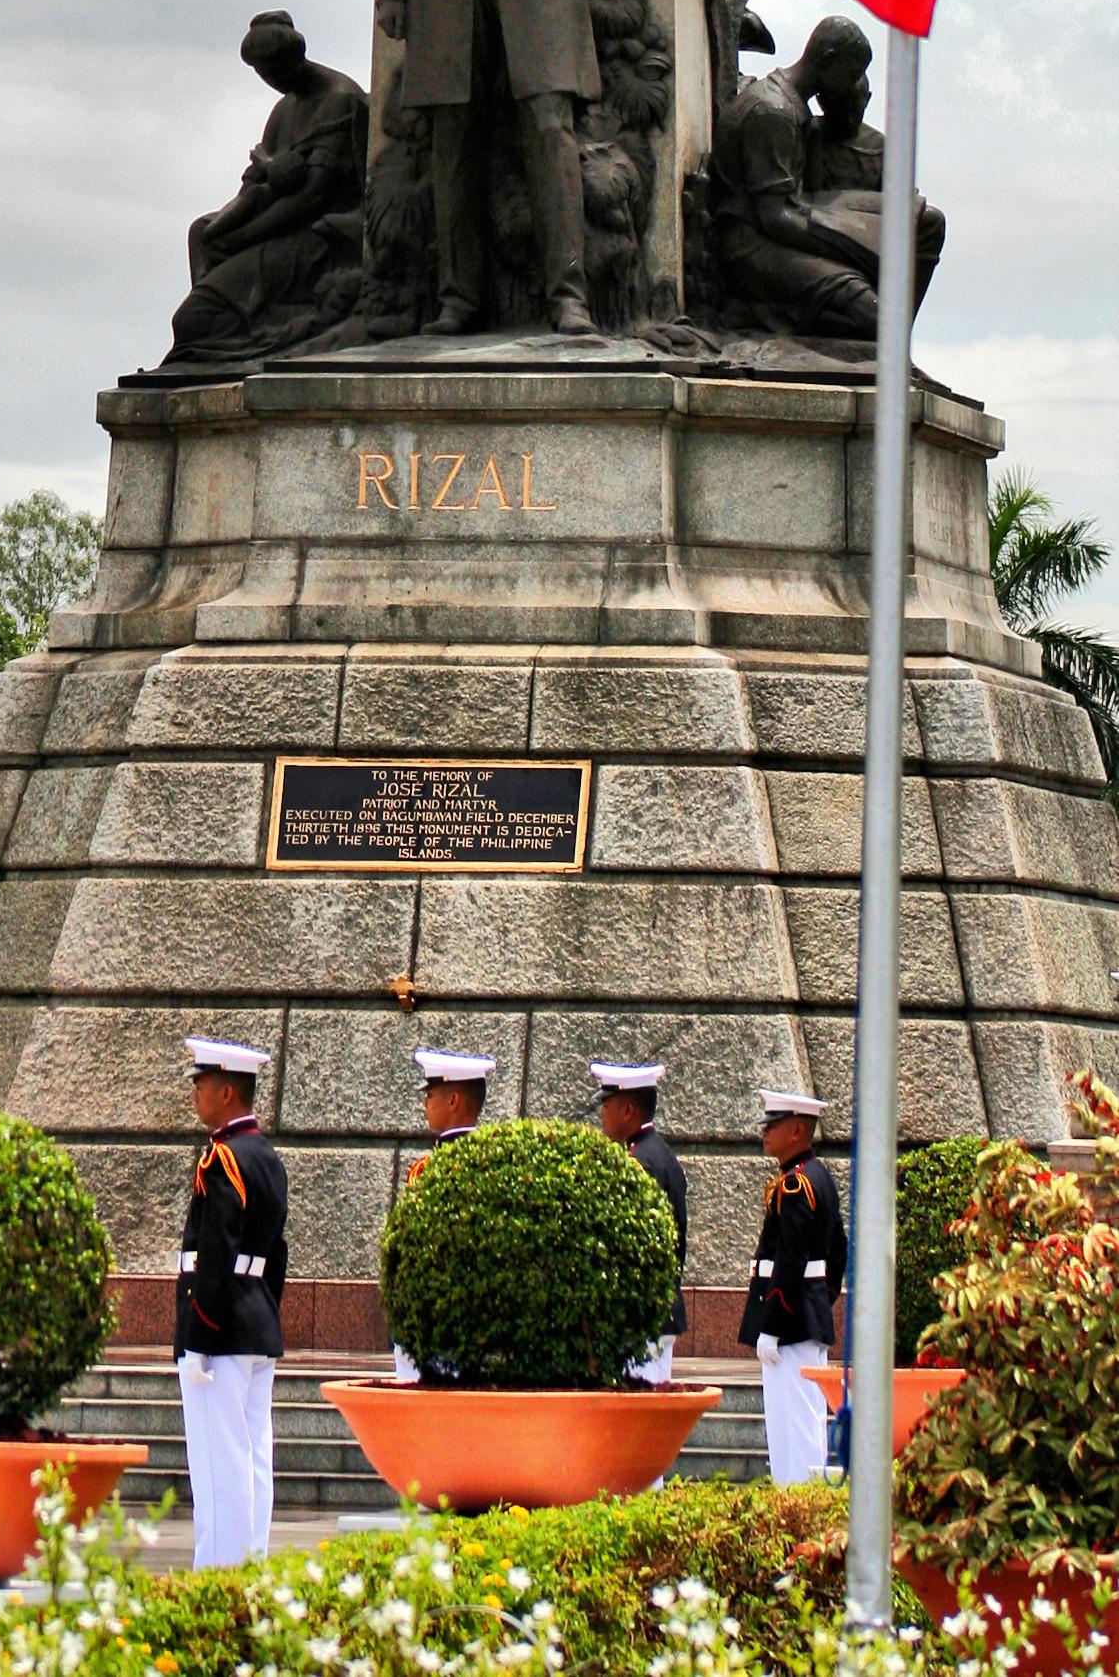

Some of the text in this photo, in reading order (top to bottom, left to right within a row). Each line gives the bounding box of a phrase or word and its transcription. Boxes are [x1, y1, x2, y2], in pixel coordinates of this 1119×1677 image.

[357, 451, 559, 511] RIZAL
[372, 770, 494, 782] TO THE MEMORY OF
[433, 783, 485, 799] RIZAL
[362, 798, 498, 811] PATRIOT AND MARTYR
[285, 809, 576, 825] EXECUTED ON BAGUMBAYAN FIELD DECEMBER
[285, 822, 572, 838] THIRTIETH 1896 THIS MONUMENT IS DEDICA-
[284, 834, 553, 850] TED BY THE PEOPLE OF THE PHILIPPINE
[398, 848, 457, 859] ISLANDS.
